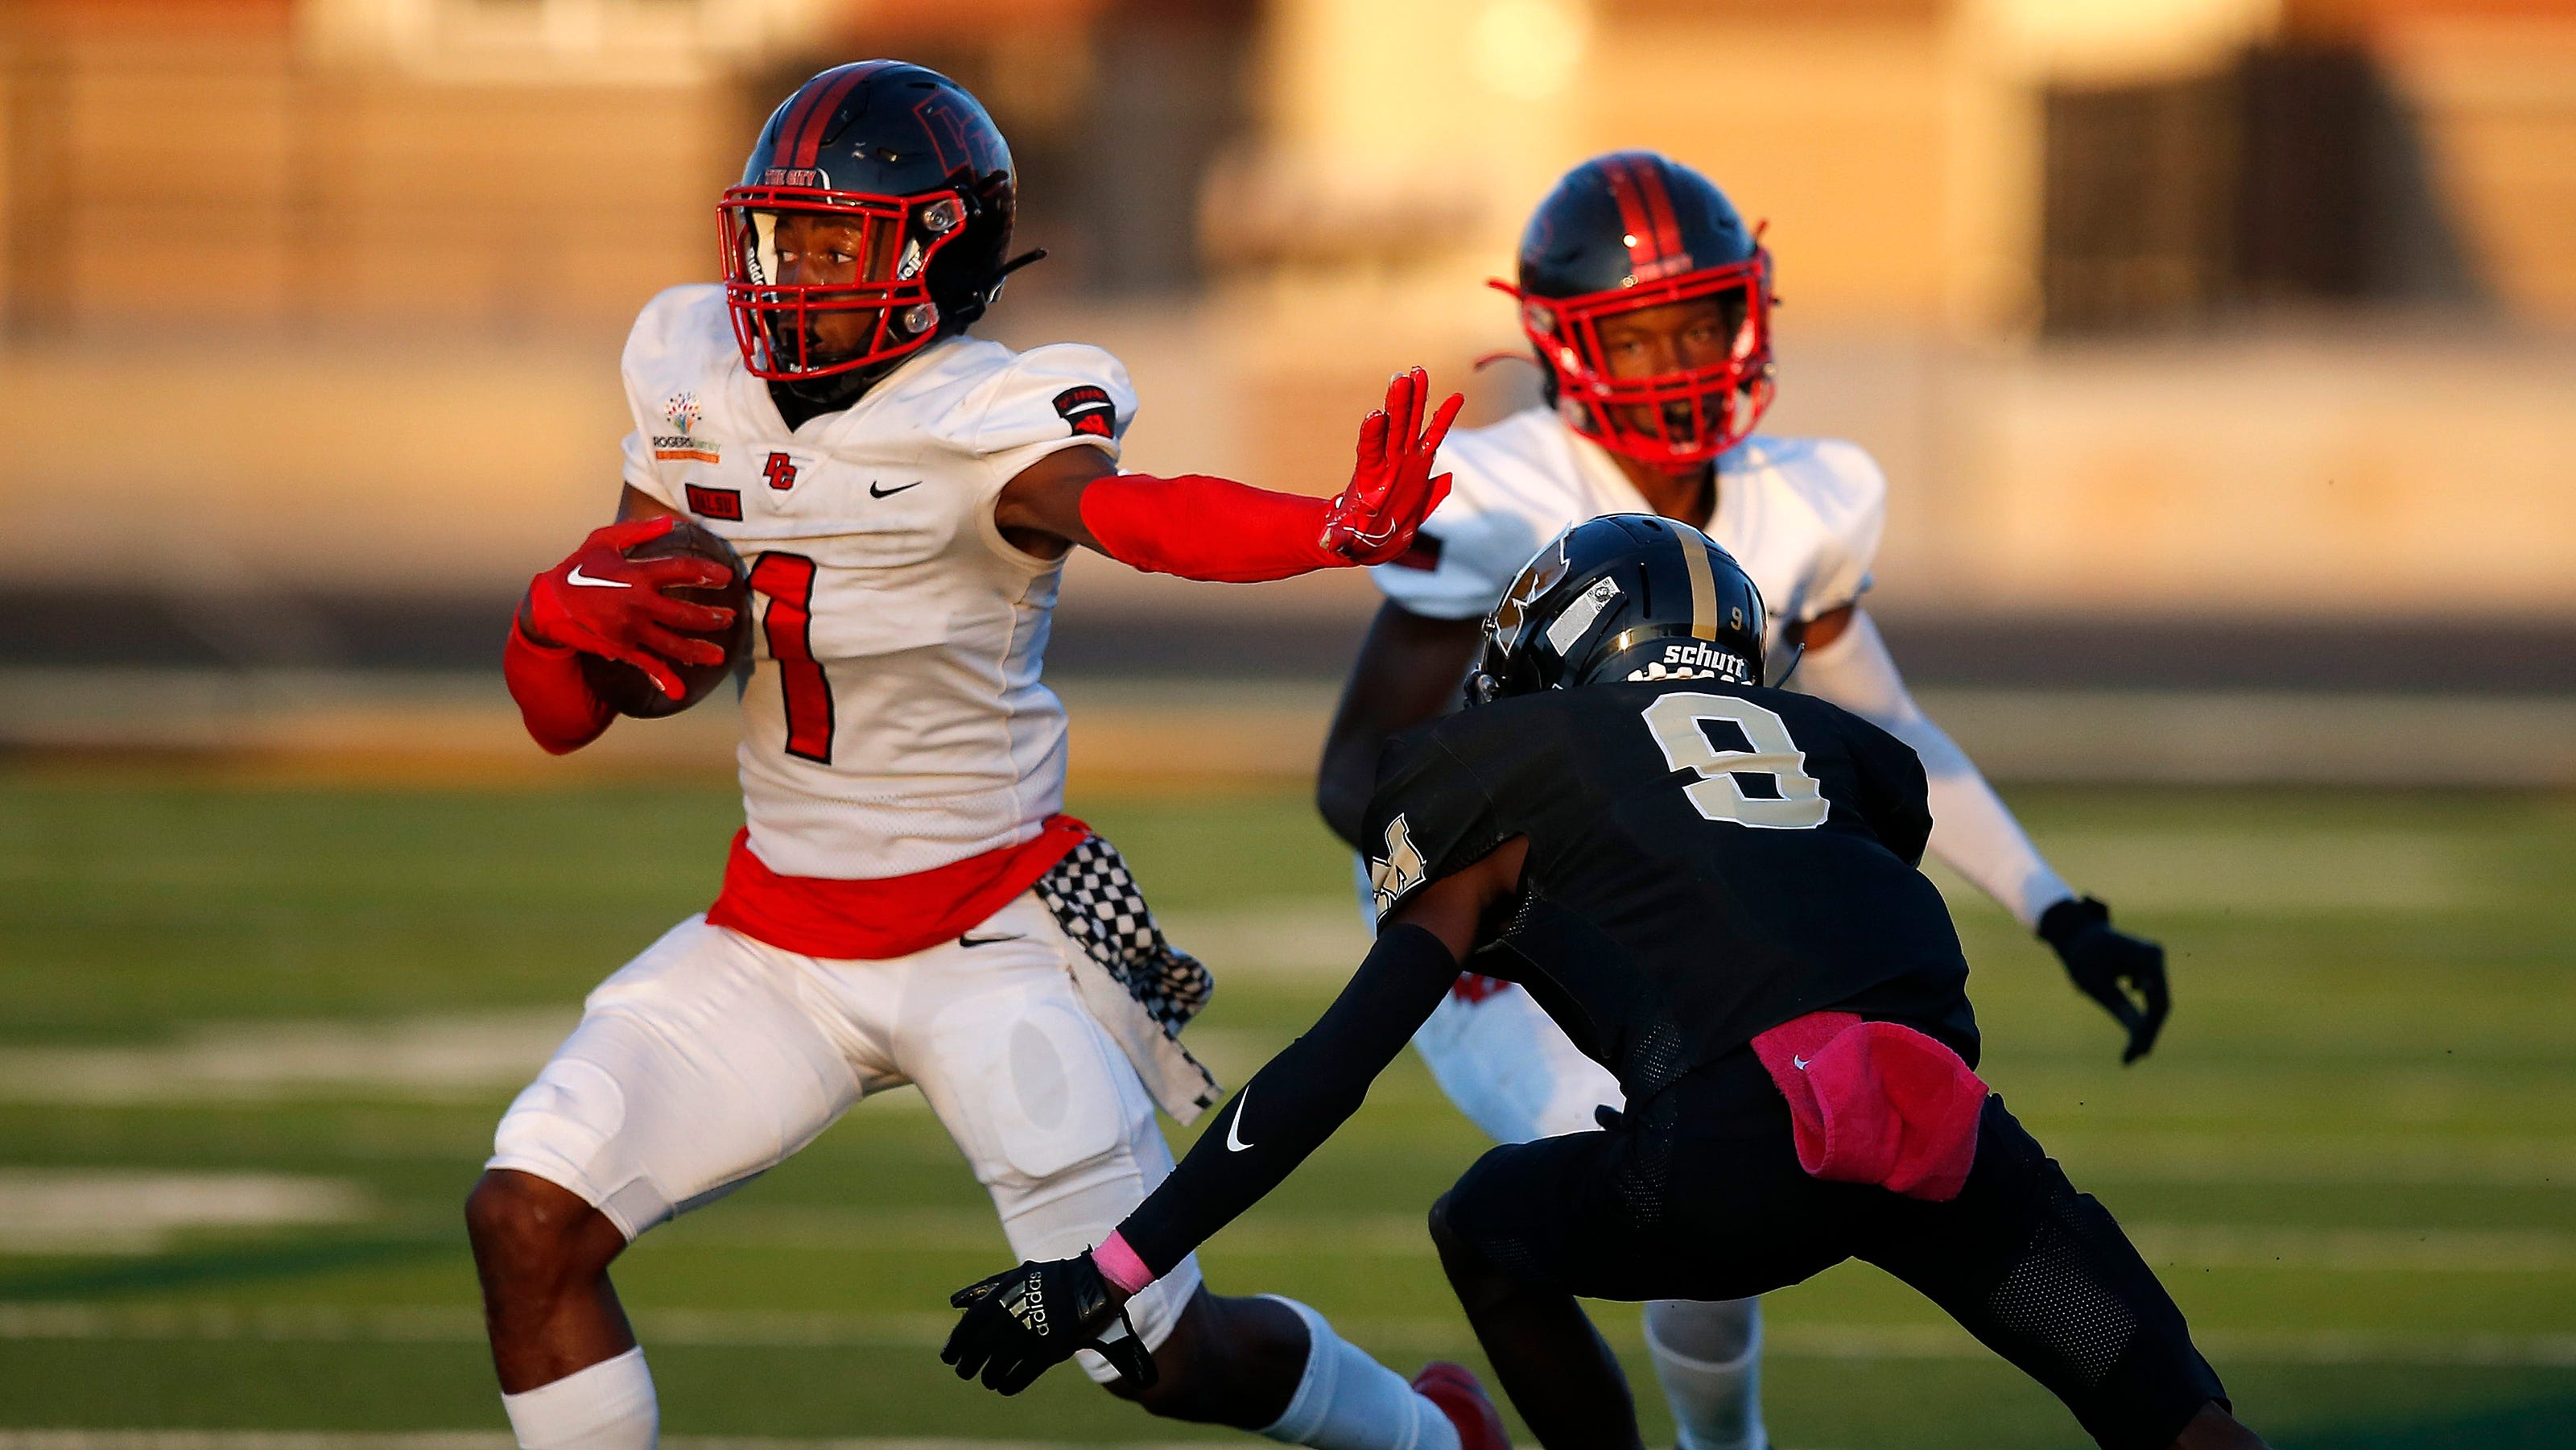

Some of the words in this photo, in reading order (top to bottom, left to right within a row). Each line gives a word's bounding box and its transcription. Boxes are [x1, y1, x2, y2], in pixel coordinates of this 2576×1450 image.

[786, 169, 817, 187] CITY
[1730, 606, 1743, 630] 9
[747, 551, 836, 766] 1
[1663, 642, 1745, 678] schutt
[1641, 692, 1830, 829] 9
[1026, 1271, 1050, 1336] adidas
